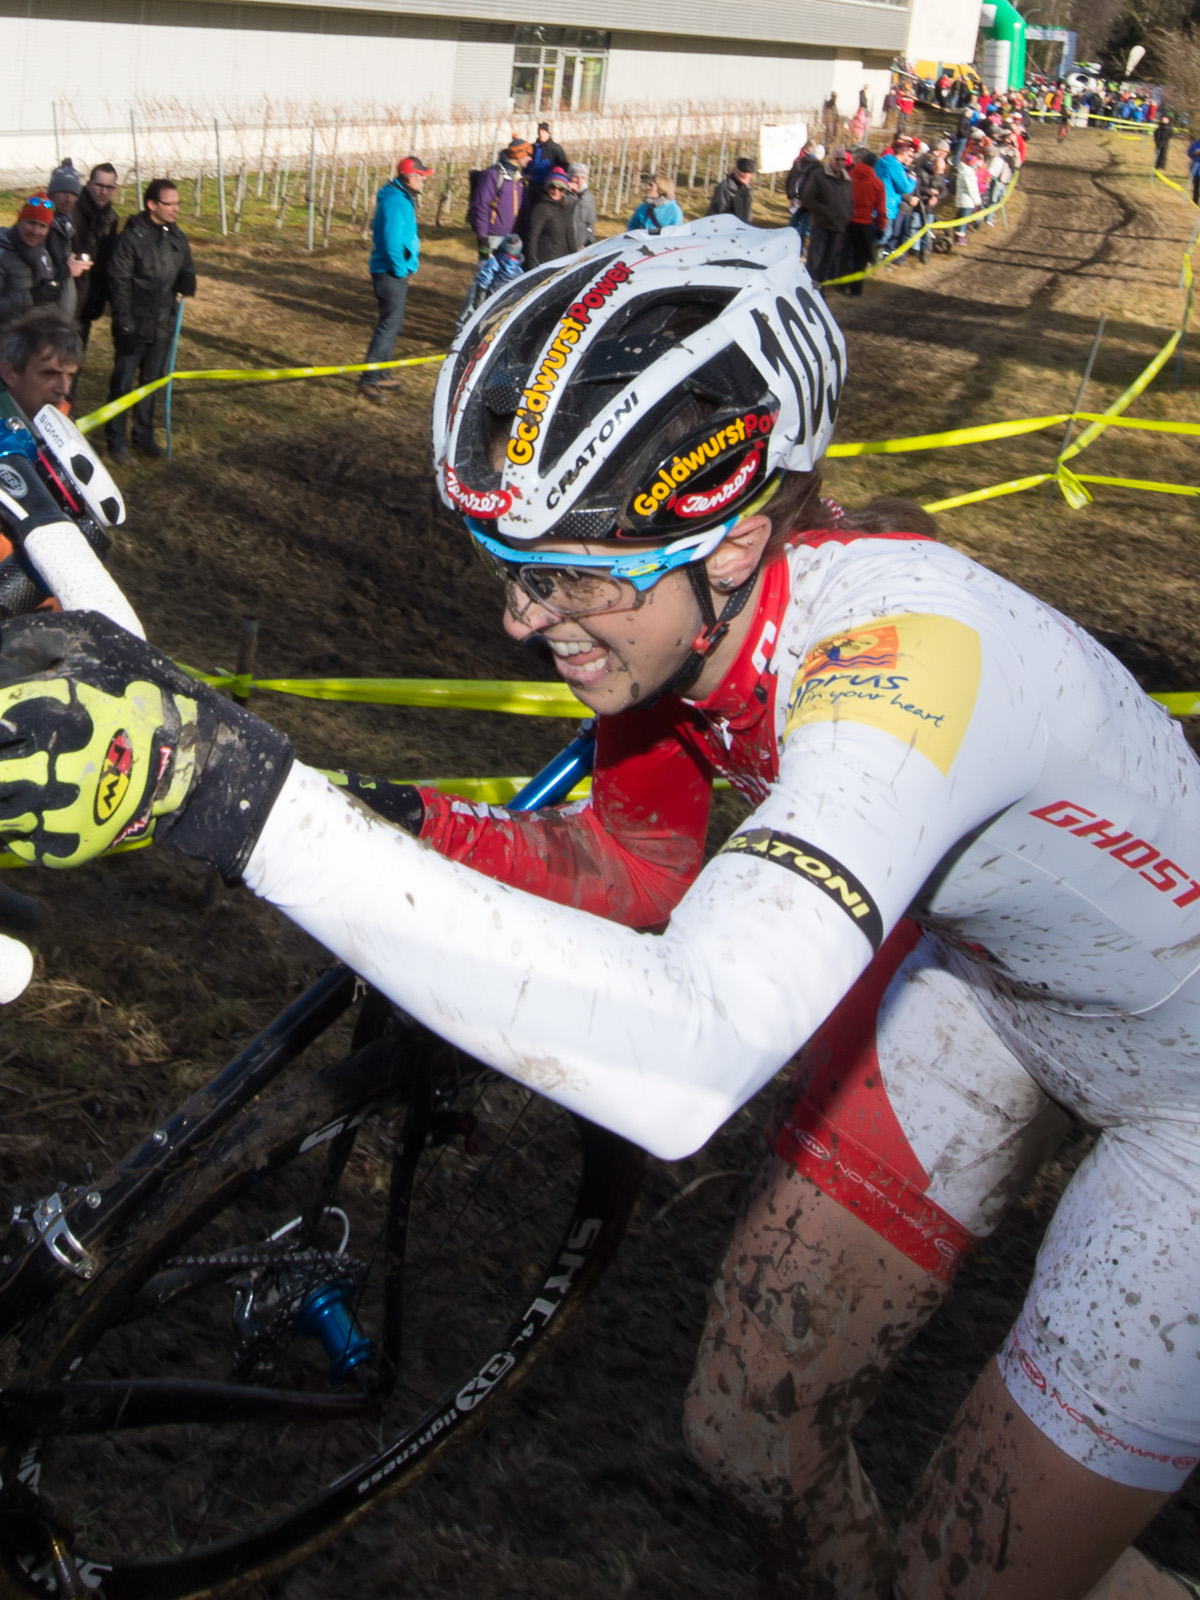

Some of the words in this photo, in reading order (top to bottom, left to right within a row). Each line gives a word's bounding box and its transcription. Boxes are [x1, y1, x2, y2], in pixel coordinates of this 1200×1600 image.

[749, 286, 842, 445] 103
[38, 413, 66, 450] SIGMA
[546, 391, 640, 510] CRATONI
[829, 689, 887, 705] your
[890, 693, 946, 728] heart
[1028, 800, 1200, 909] GHOST
[356, 1409, 459, 1495] lightness
